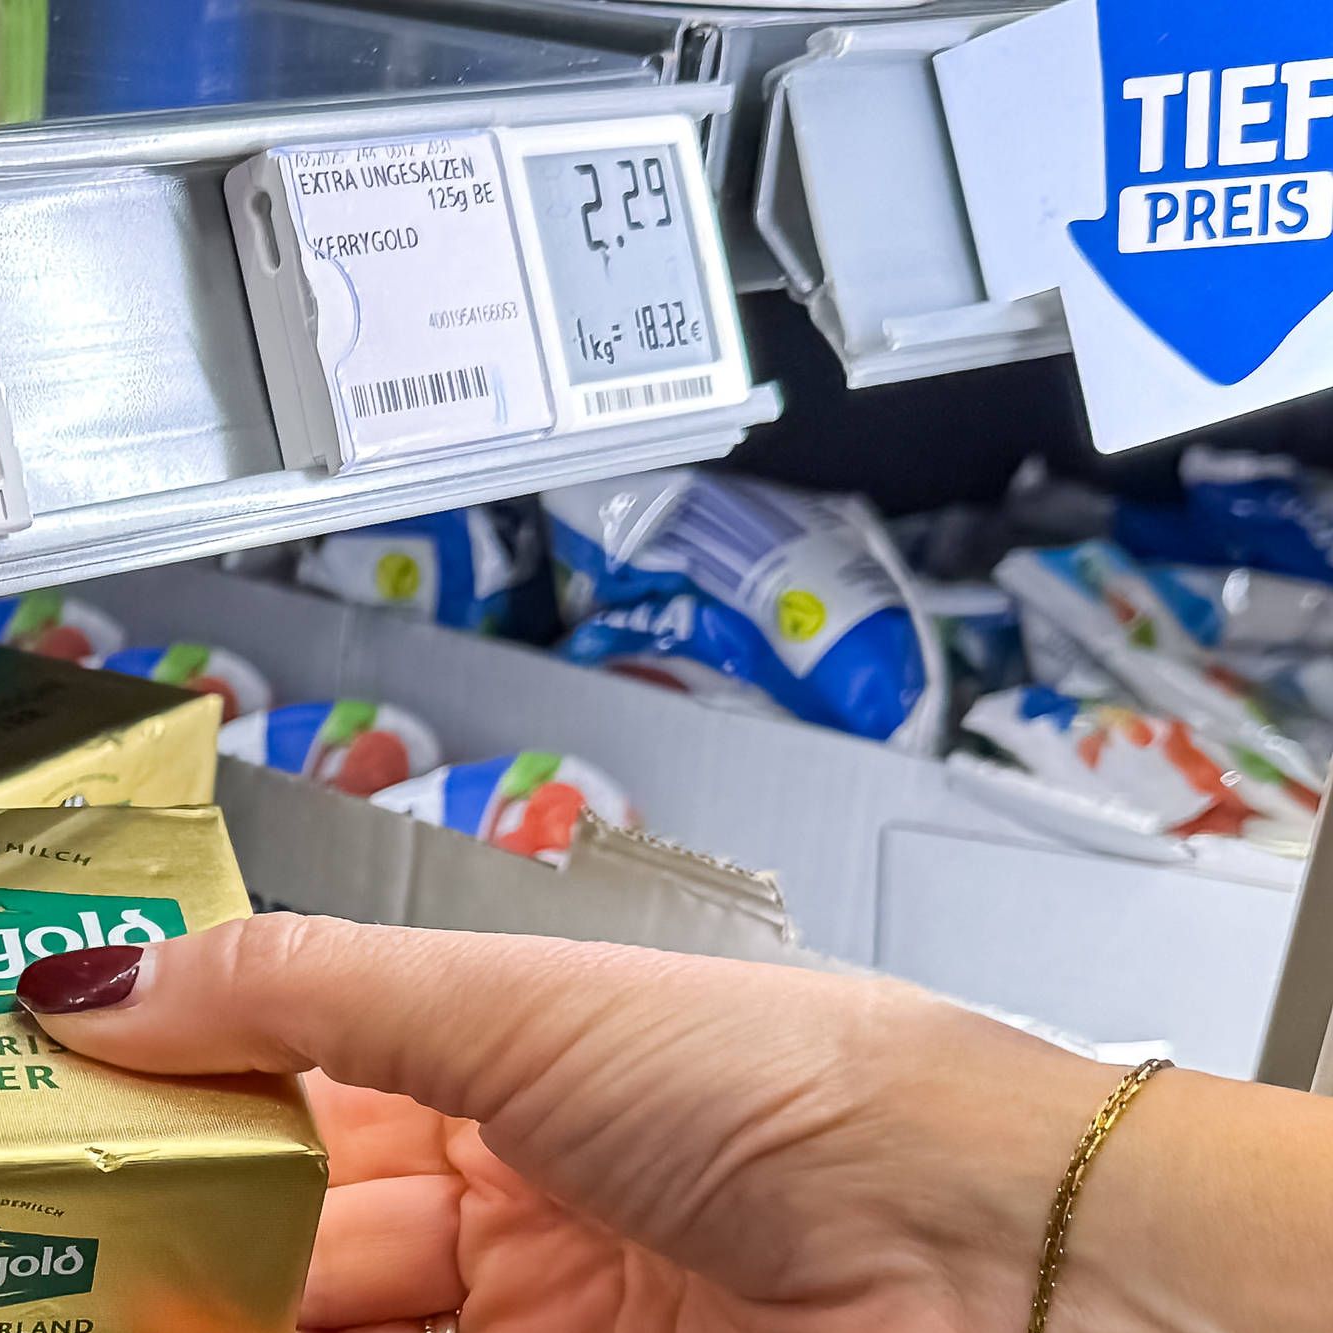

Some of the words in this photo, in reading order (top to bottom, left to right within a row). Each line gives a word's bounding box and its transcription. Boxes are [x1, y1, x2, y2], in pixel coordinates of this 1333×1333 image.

[1122, 58, 1333, 172] TIEF
[299, 168, 358, 195] EXTRA
[360, 156, 475, 188] UNGESALZEN
[428, 186, 468, 212] 125g
[473, 182, 495, 205] BE
[574, 158, 672, 251] 2.29
[1145, 181, 1310, 244] PREIS
